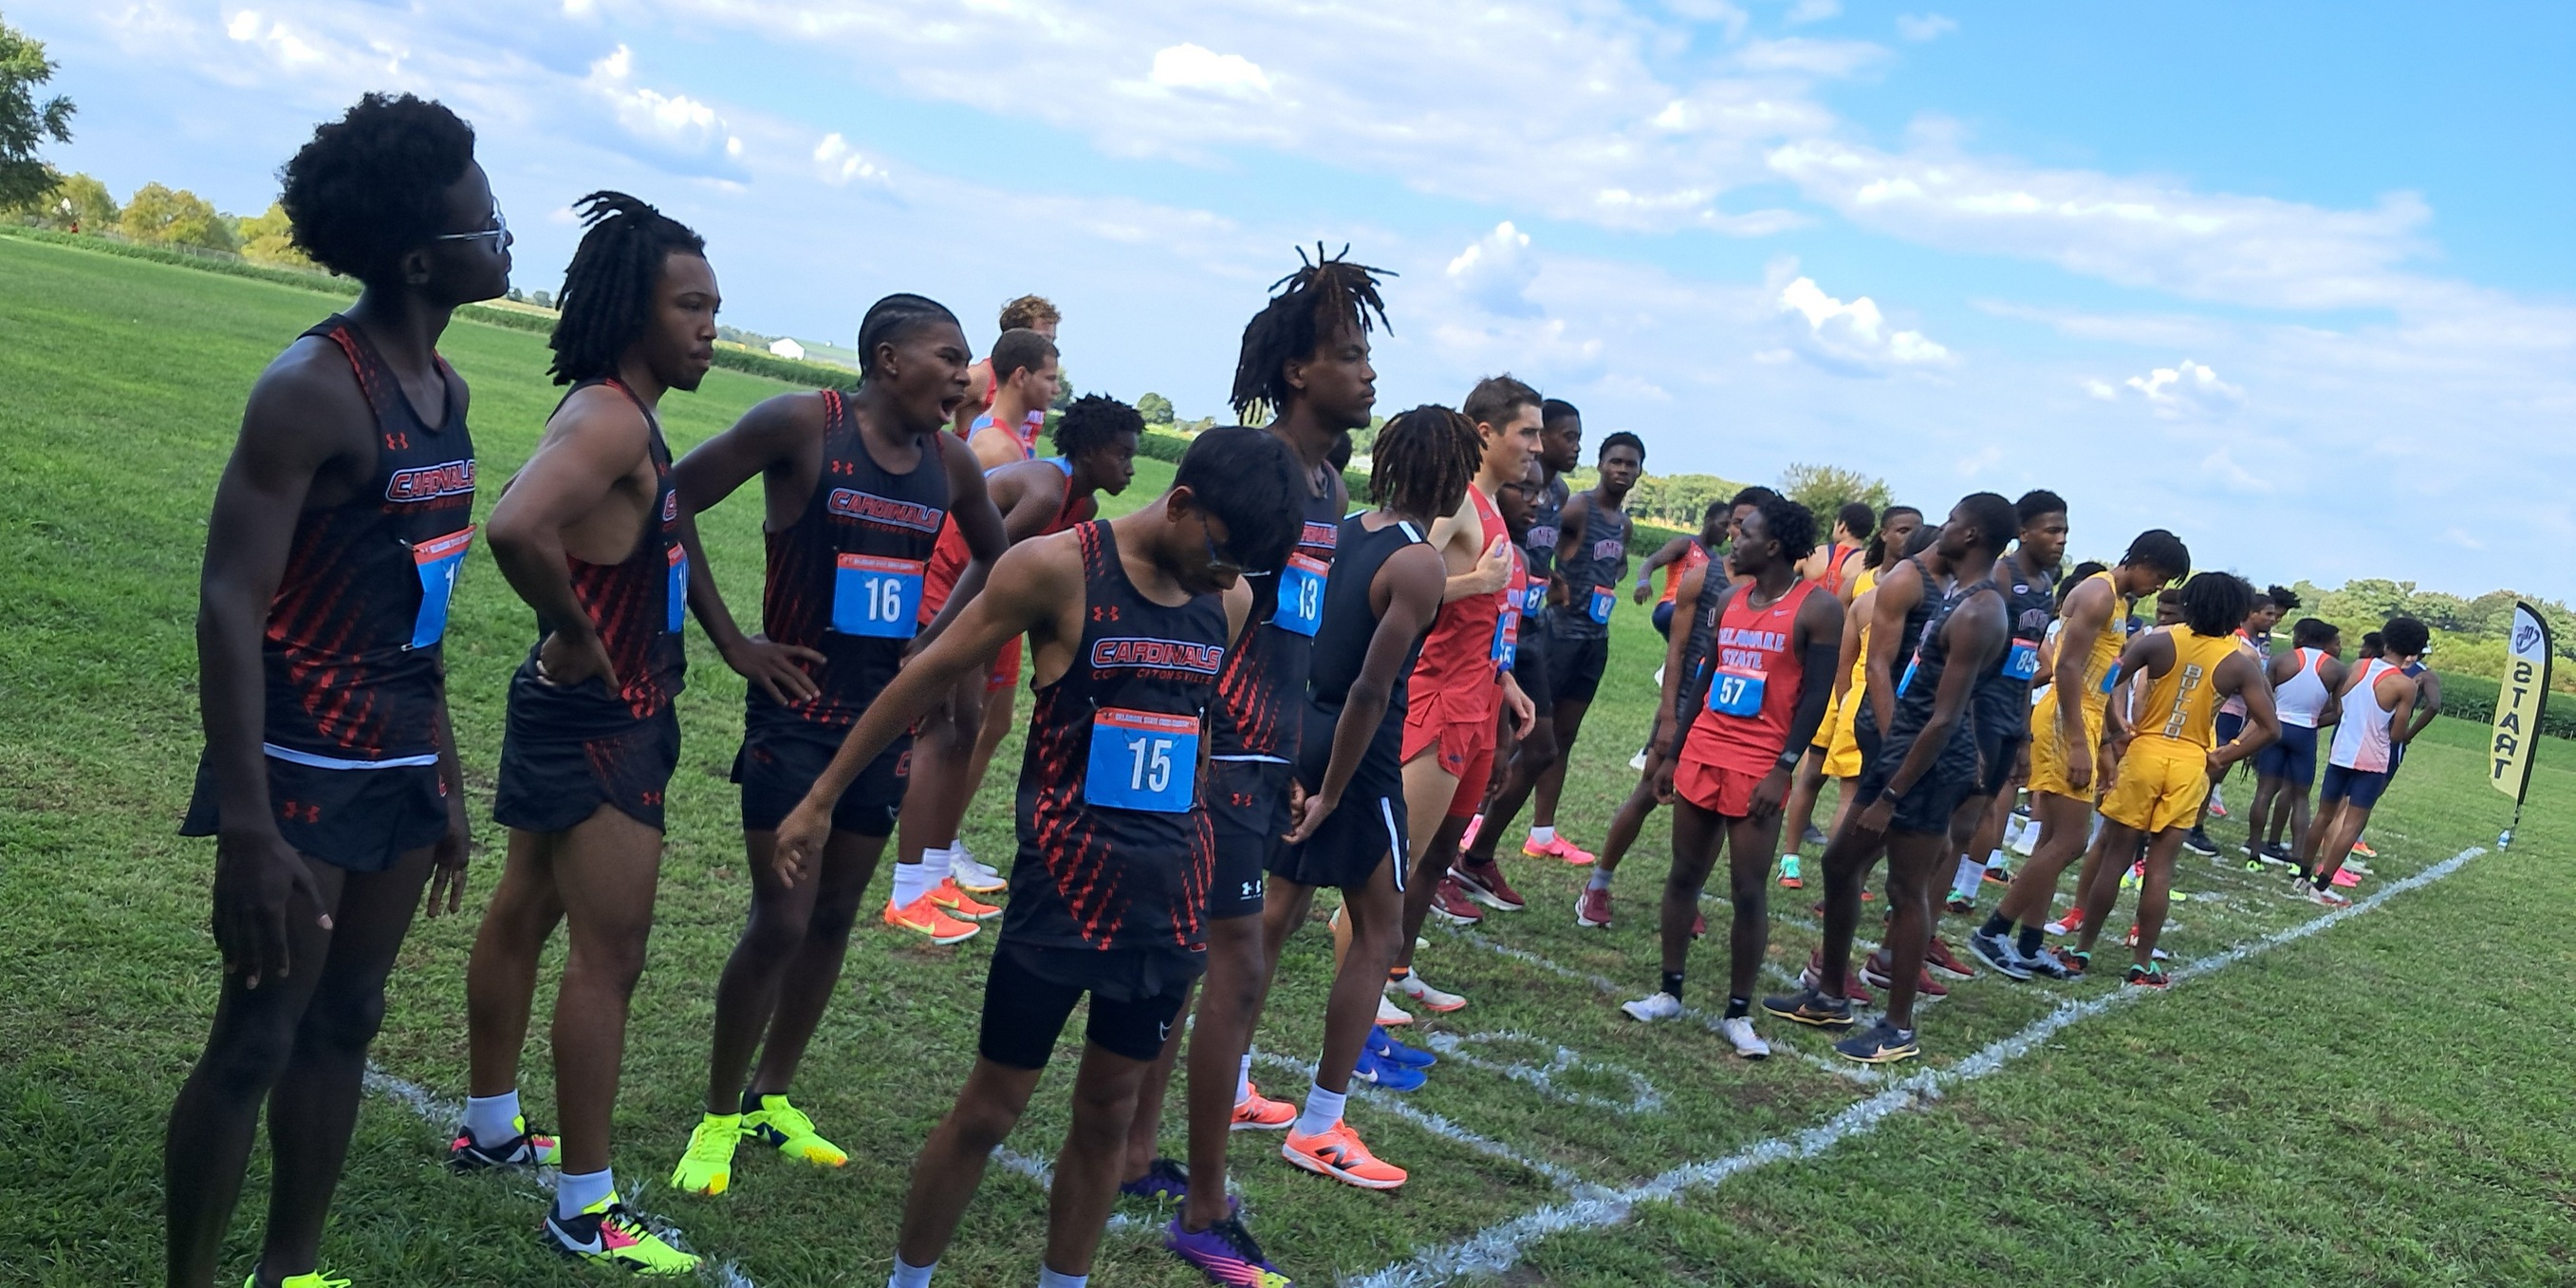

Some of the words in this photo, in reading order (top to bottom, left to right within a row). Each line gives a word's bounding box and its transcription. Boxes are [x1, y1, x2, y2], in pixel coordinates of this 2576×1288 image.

[829, 490, 941, 531] CARDINALS
[864, 577, 901, 623] 16
[1299, 576, 1318, 621] 13
[1093, 640, 1224, 672] CARDINALS
[1722, 648, 1762, 669] STATE
[2016, 650, 2037, 673] 85
[1720, 677, 1746, 705] 57
[1128, 737, 1172, 793] 15
